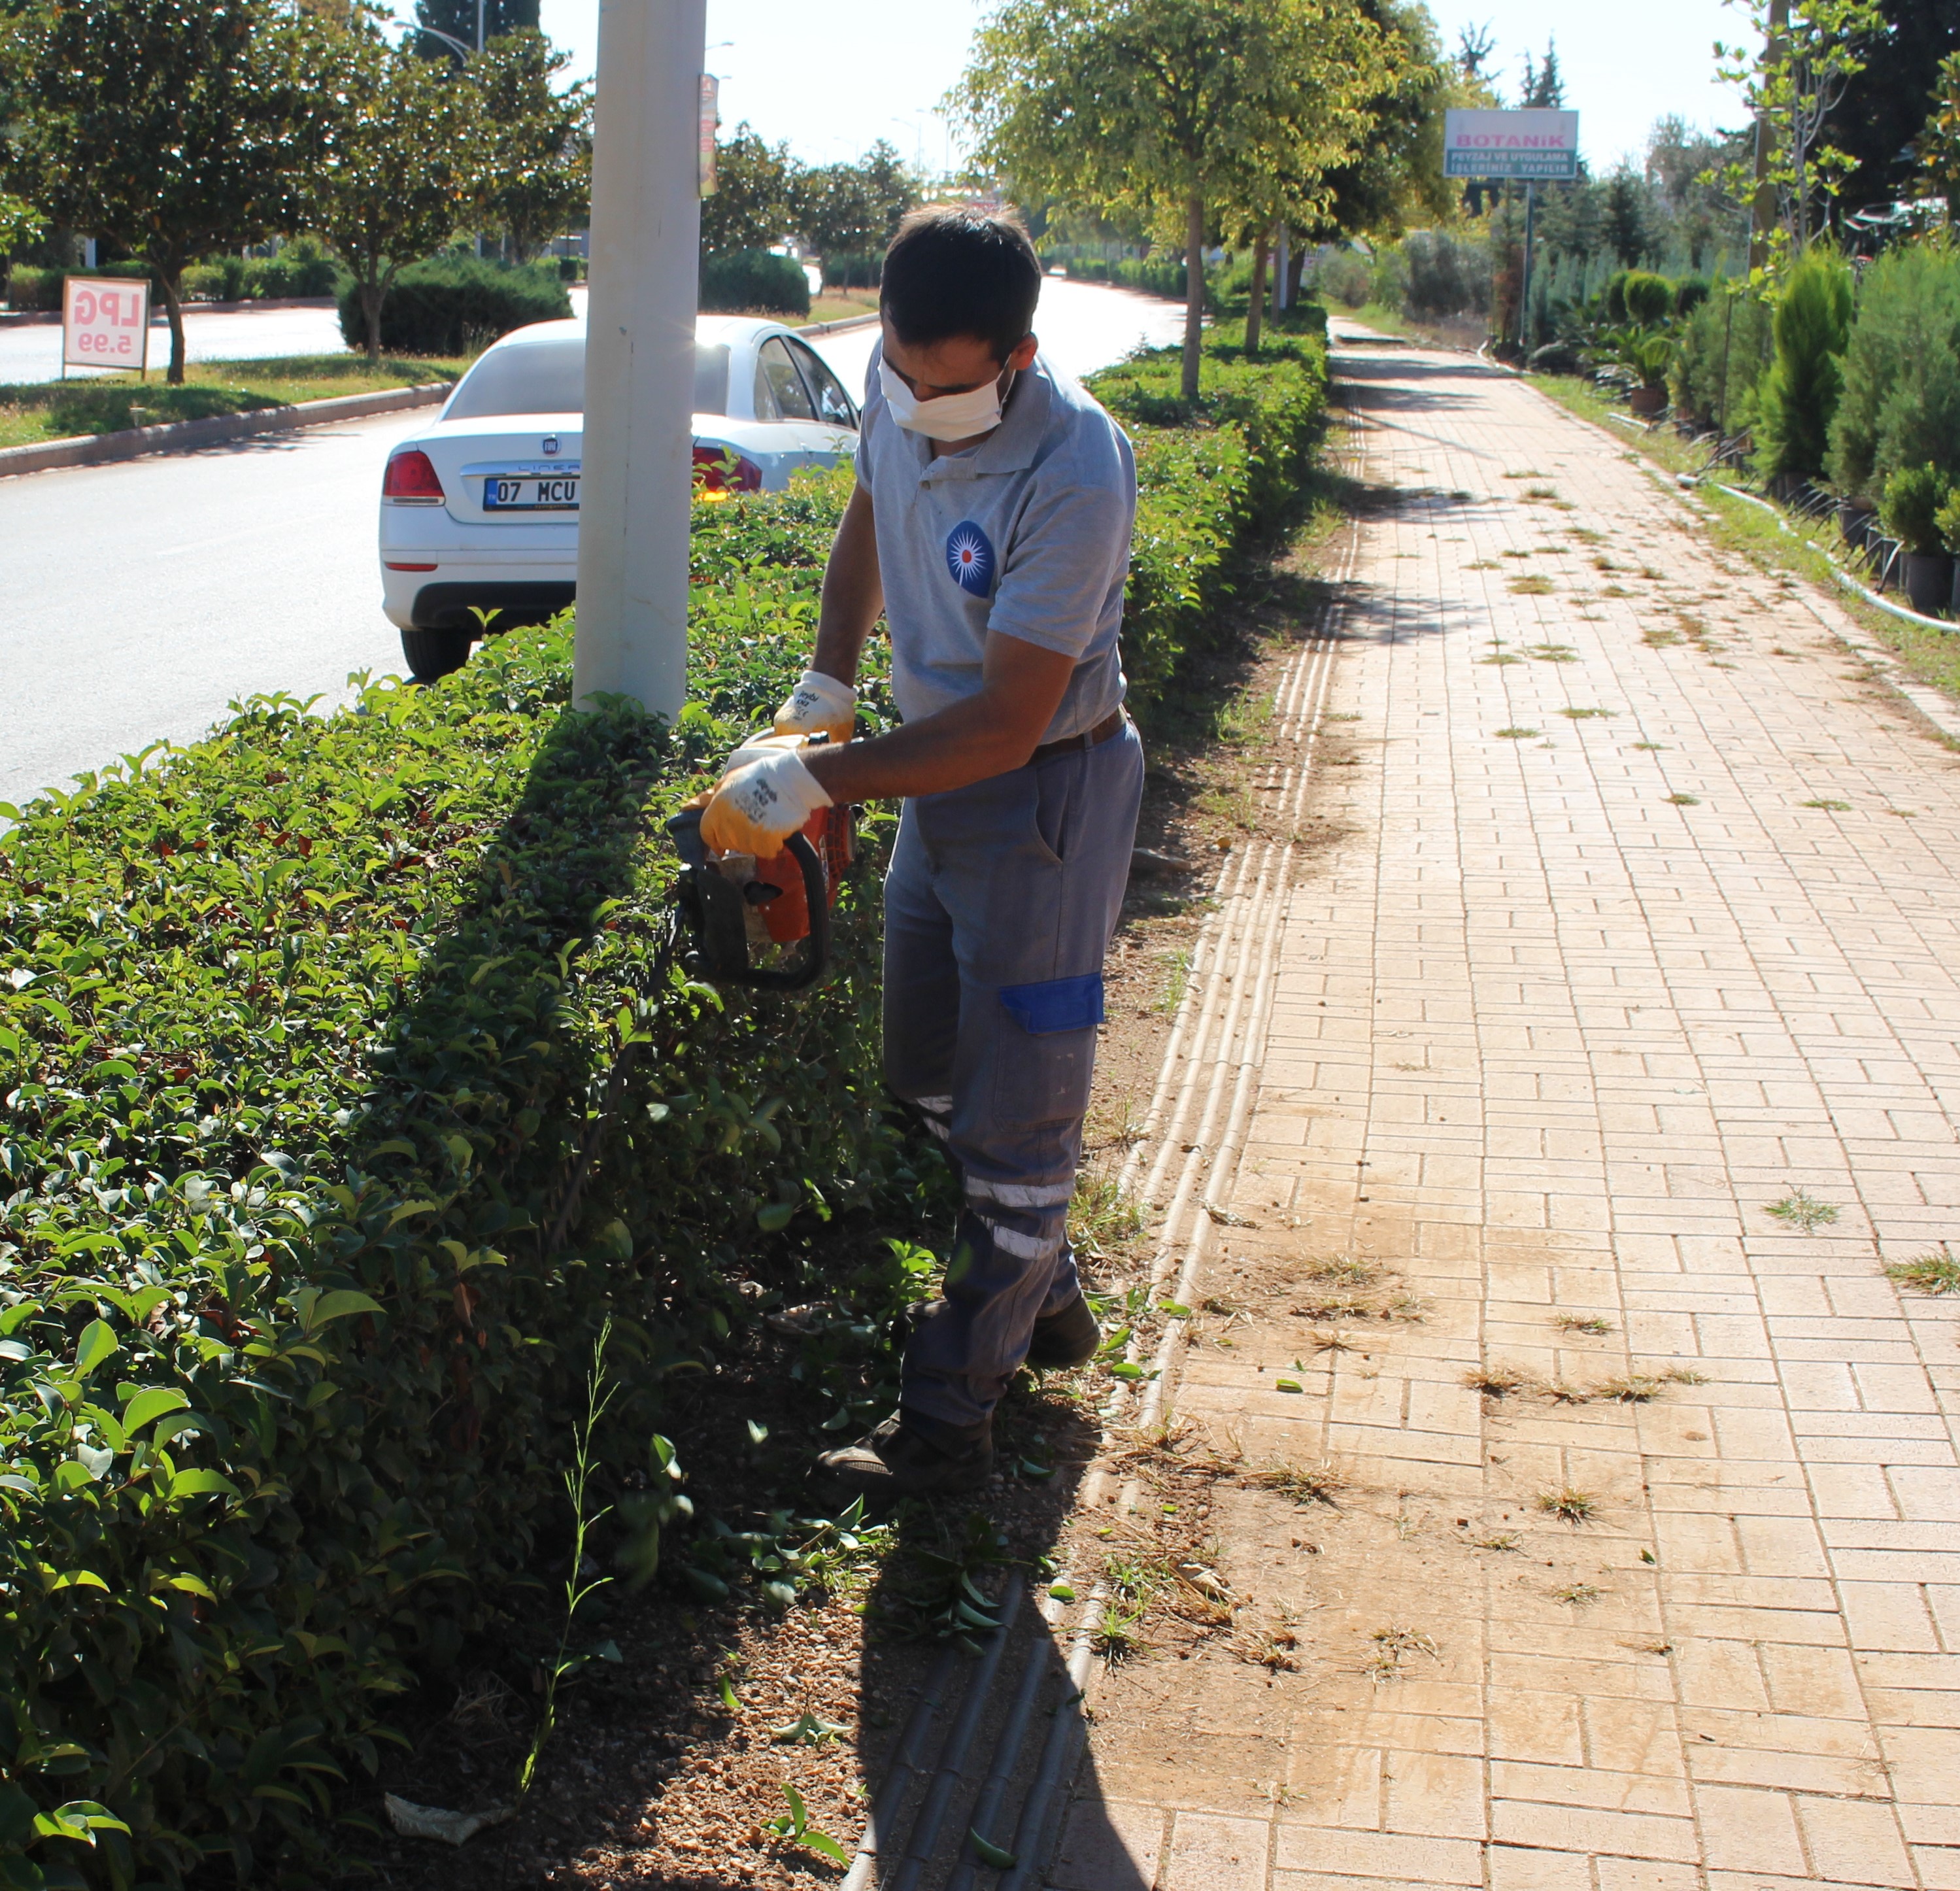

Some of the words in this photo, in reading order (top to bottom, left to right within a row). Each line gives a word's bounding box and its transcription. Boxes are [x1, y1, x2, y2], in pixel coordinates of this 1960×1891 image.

[1451, 152, 1491, 161] PEYZAJ
[1493, 152, 1507, 161] VE
[1511, 152, 1568, 161] UYGULAMA
[1522, 163, 1568, 173] YAPILIR
[498, 482, 521, 502] 07
[537, 481, 575, 502] MCU
